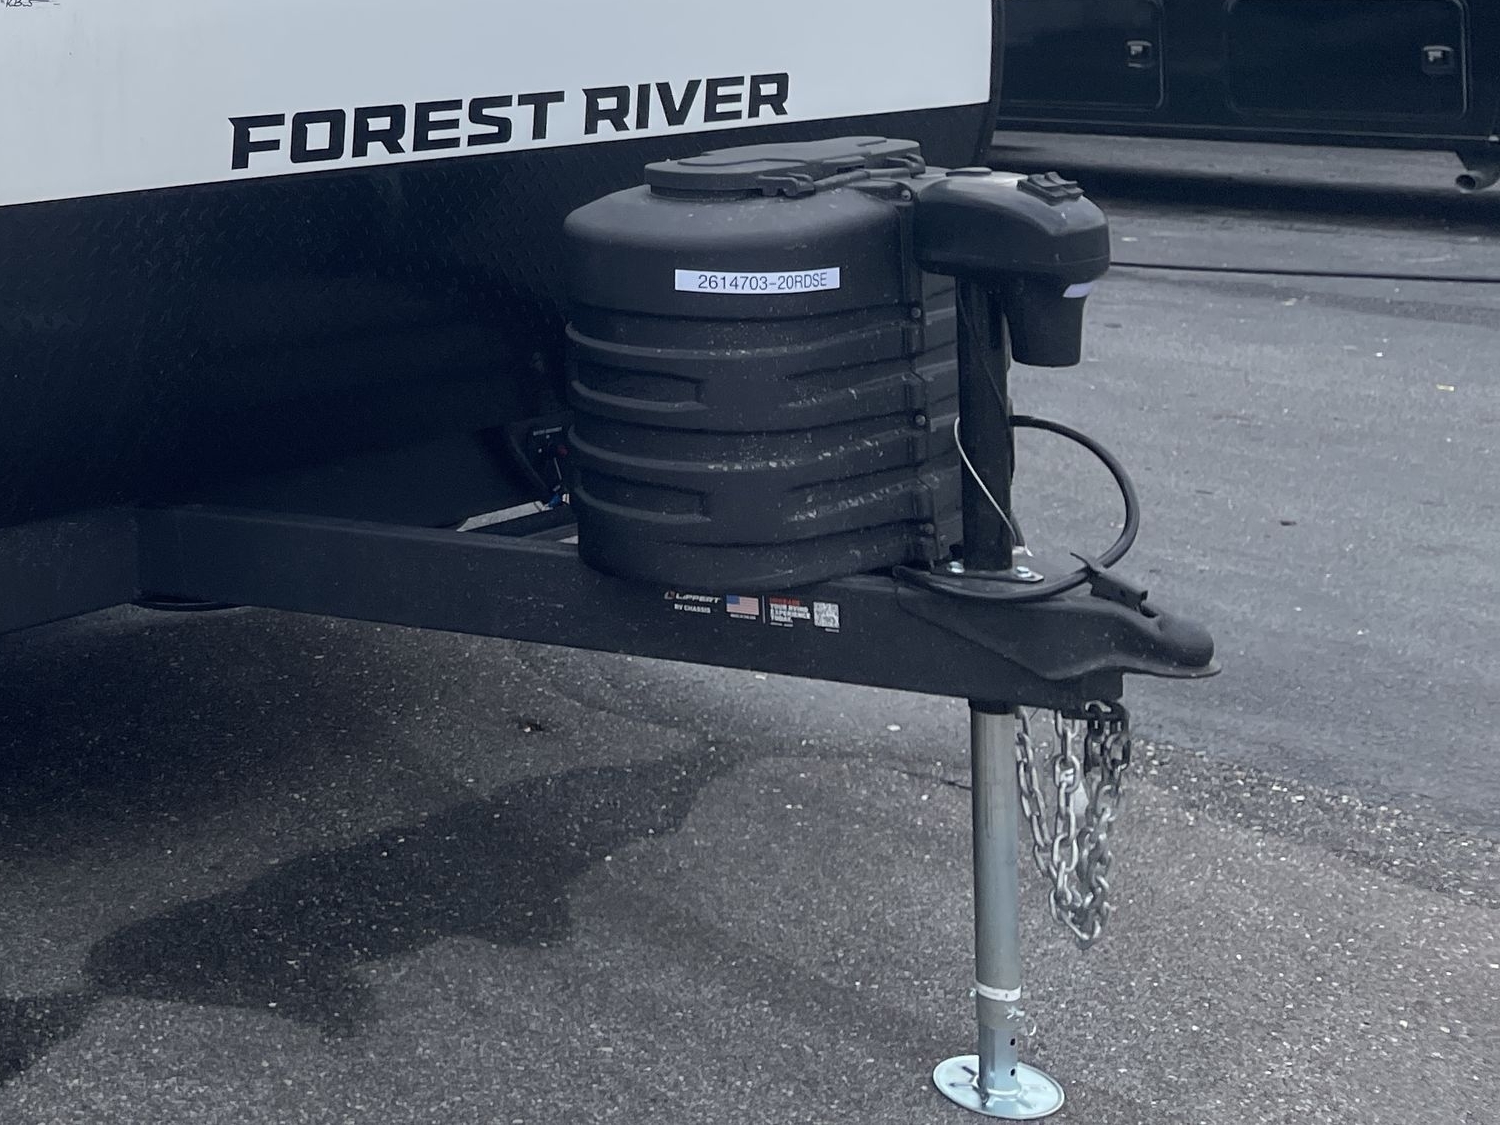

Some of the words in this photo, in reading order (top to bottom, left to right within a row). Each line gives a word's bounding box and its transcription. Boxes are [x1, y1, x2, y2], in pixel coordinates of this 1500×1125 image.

[227, 90, 565, 170] FOREST
[582, 72, 790, 136] RIVER
[698, 272, 828, 291] 2614703-20RDSE
